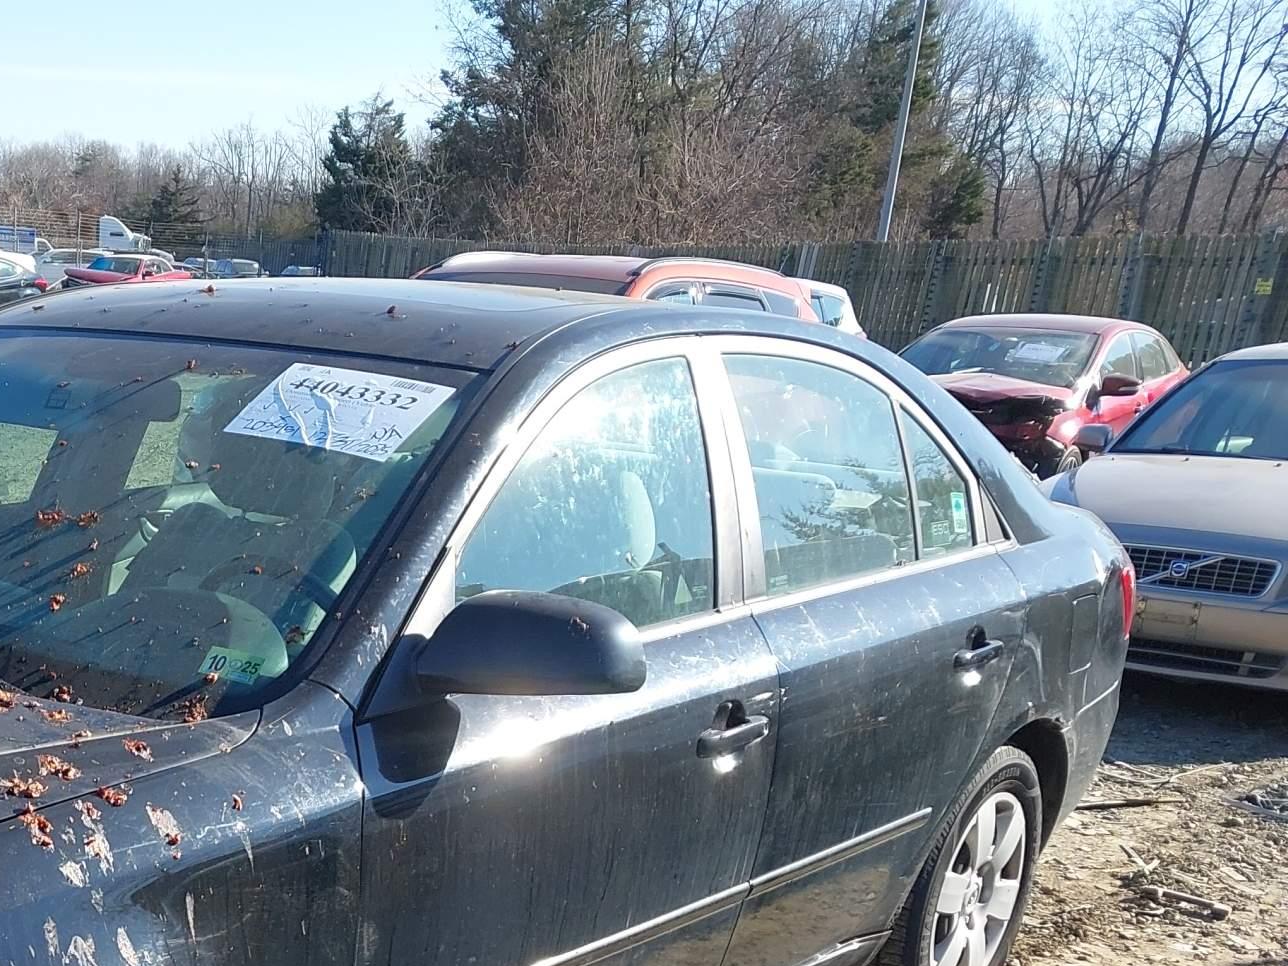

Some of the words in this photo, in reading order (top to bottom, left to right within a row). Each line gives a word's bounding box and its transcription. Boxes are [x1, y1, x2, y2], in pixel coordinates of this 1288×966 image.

[289, 376, 419, 411] 44043332
[208, 654, 228, 672] 10
[240, 660, 261, 676] 25
